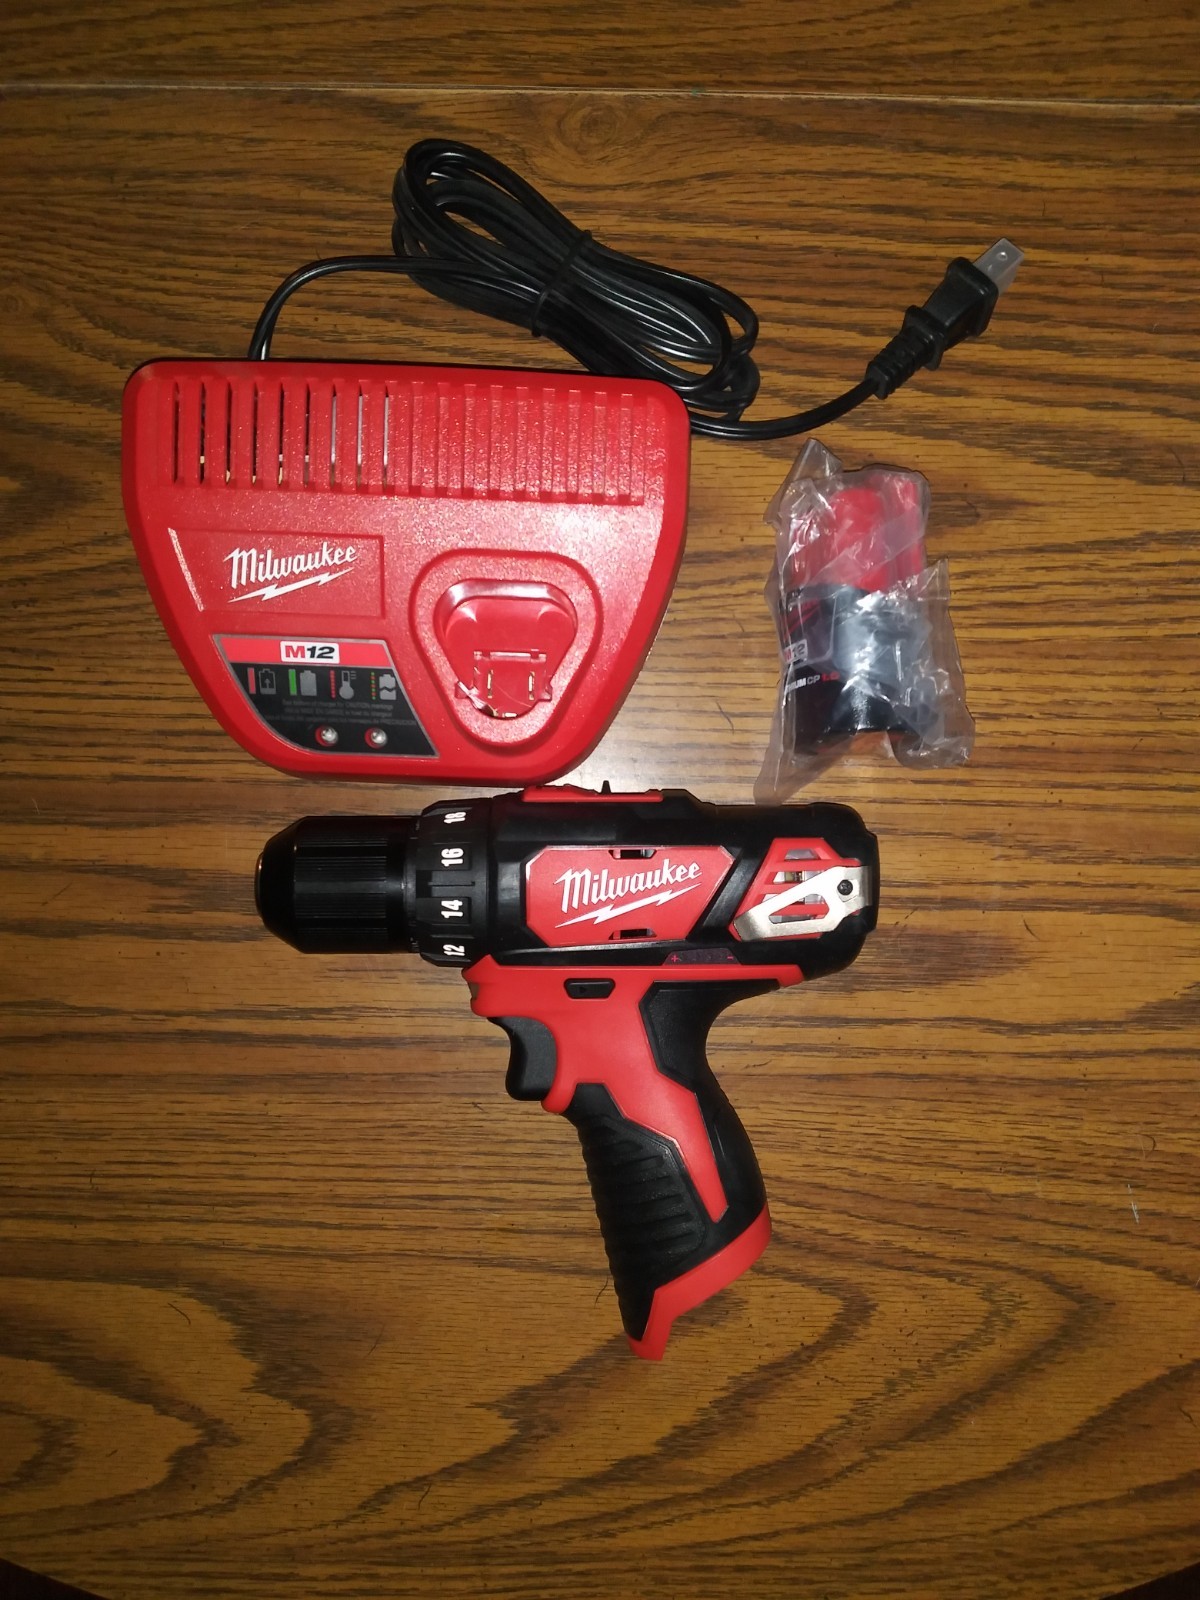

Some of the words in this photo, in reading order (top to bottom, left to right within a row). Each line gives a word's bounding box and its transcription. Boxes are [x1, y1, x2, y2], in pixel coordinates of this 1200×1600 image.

[223, 541, 358, 590] Milwaukee
[285, 645, 335, 660] M12
[443, 811, 467, 824] 18
[441, 848, 464, 867] 16
[553, 858, 703, 914] Milwaukee
[440, 899, 464, 919] 14
[442, 944, 466, 956] 12
